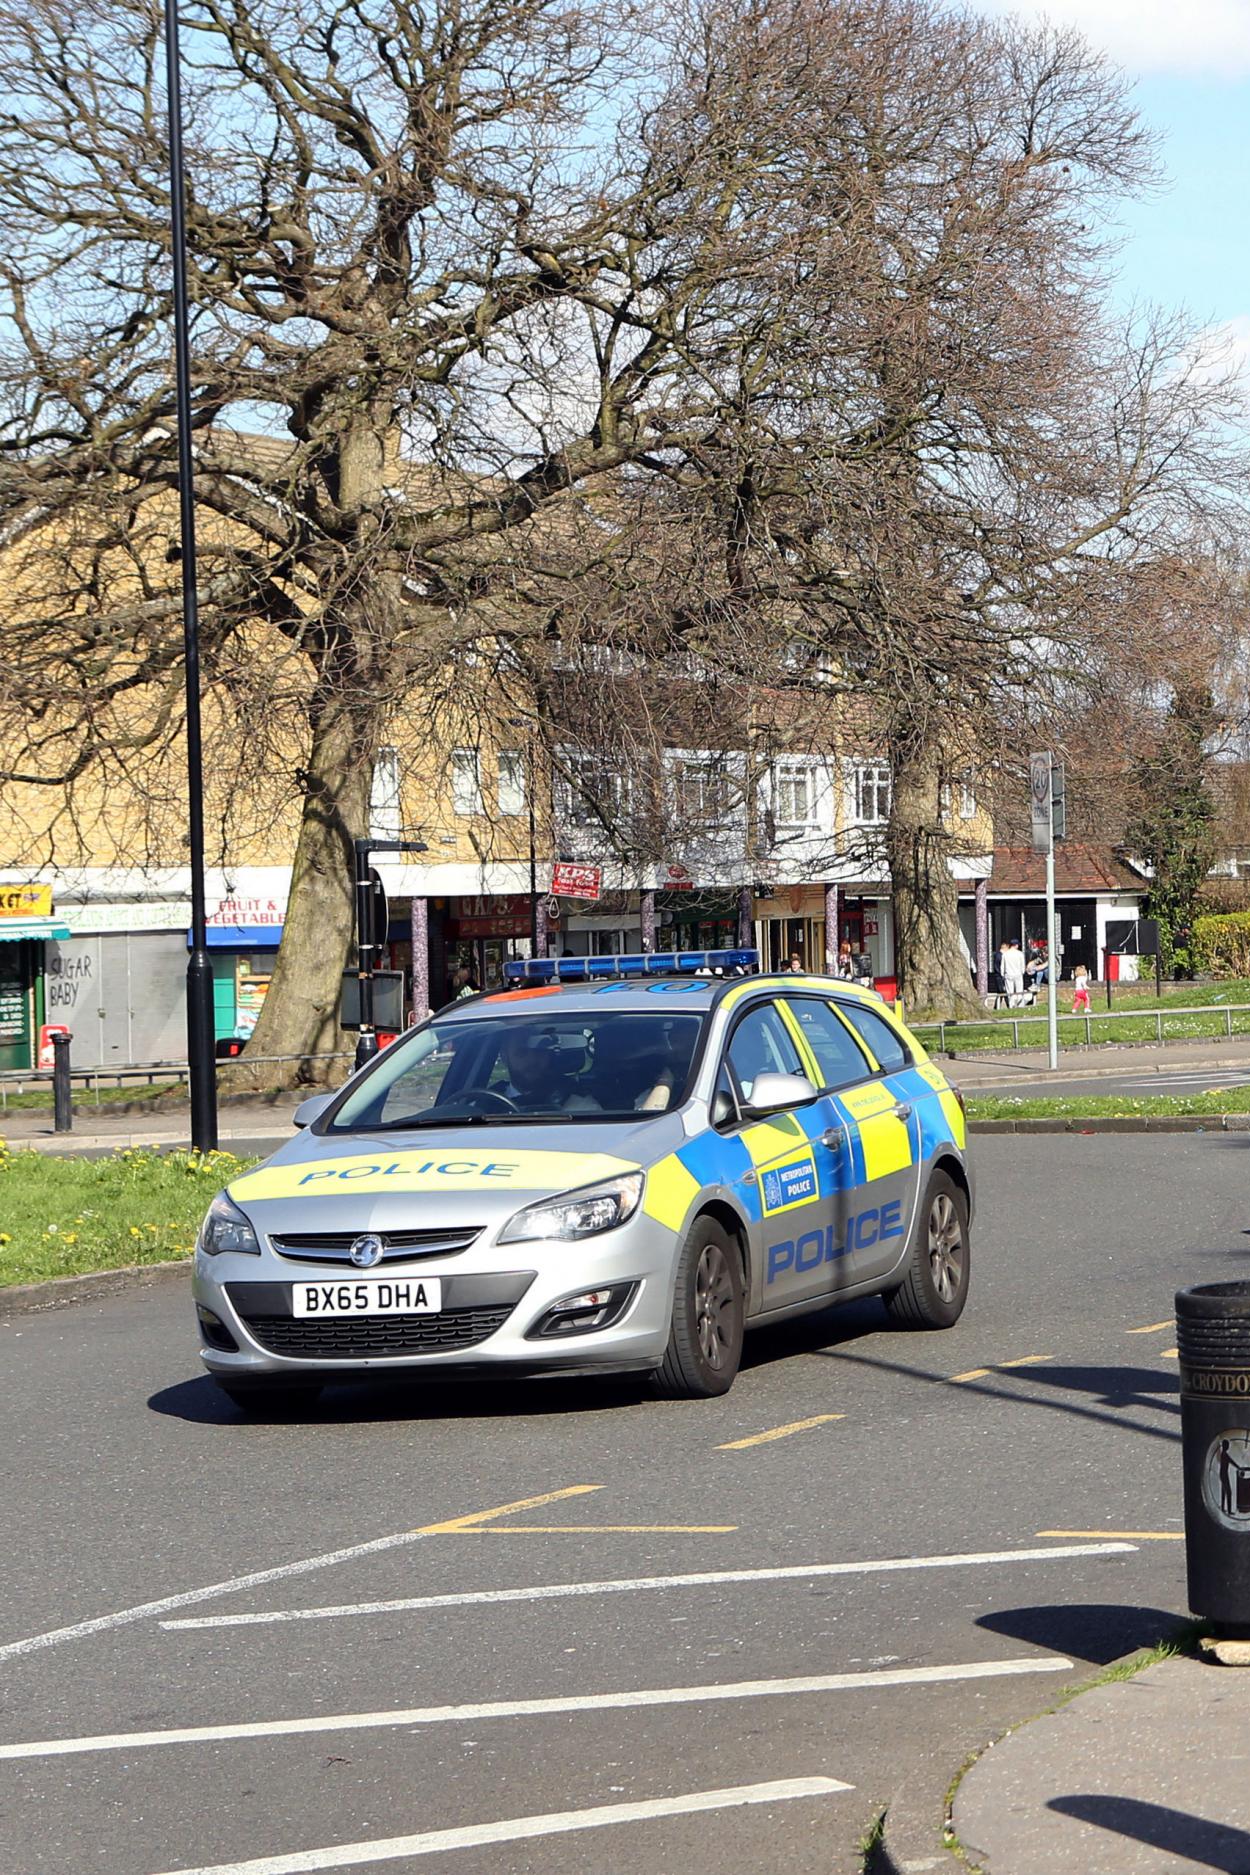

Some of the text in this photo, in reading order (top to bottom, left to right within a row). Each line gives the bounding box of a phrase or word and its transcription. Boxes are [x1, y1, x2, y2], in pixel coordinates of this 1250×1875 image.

[219, 900, 277, 911] FRUIT &
[50, 955, 92, 981] SUGAR
[50, 982, 79, 1007] BABY
[298, 1162, 520, 1186] POLICE
[780, 1165, 813, 1182] METROPOLITAN
[787, 1179, 811, 1196] POLICE
[767, 1200, 904, 1285] POLICE
[306, 1283, 428, 1312] BX65 DHA
